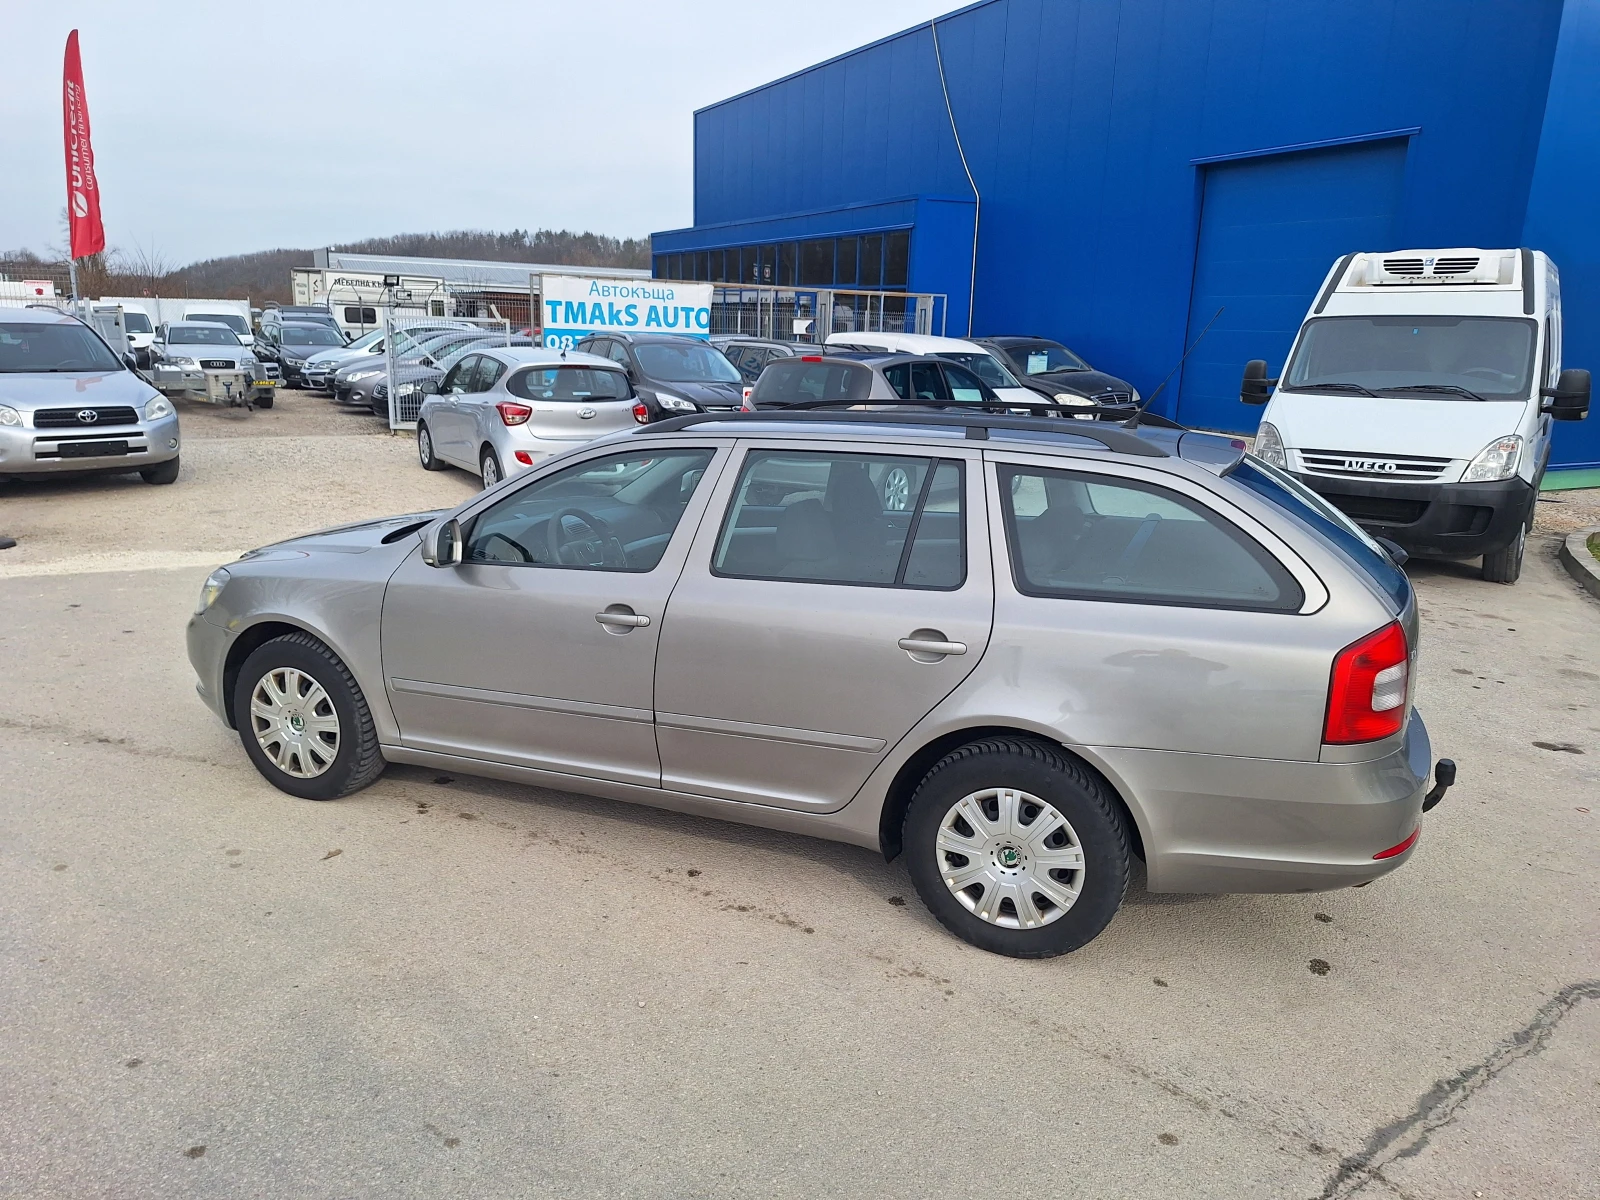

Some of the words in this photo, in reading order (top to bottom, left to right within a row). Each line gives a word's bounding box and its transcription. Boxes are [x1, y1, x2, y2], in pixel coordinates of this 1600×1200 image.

[588, 280, 675, 302] Автокъща
[545, 300, 639, 327] TMAkS
[645, 305, 710, 330] AUTO
[1344, 460, 1397, 473] IVECO
